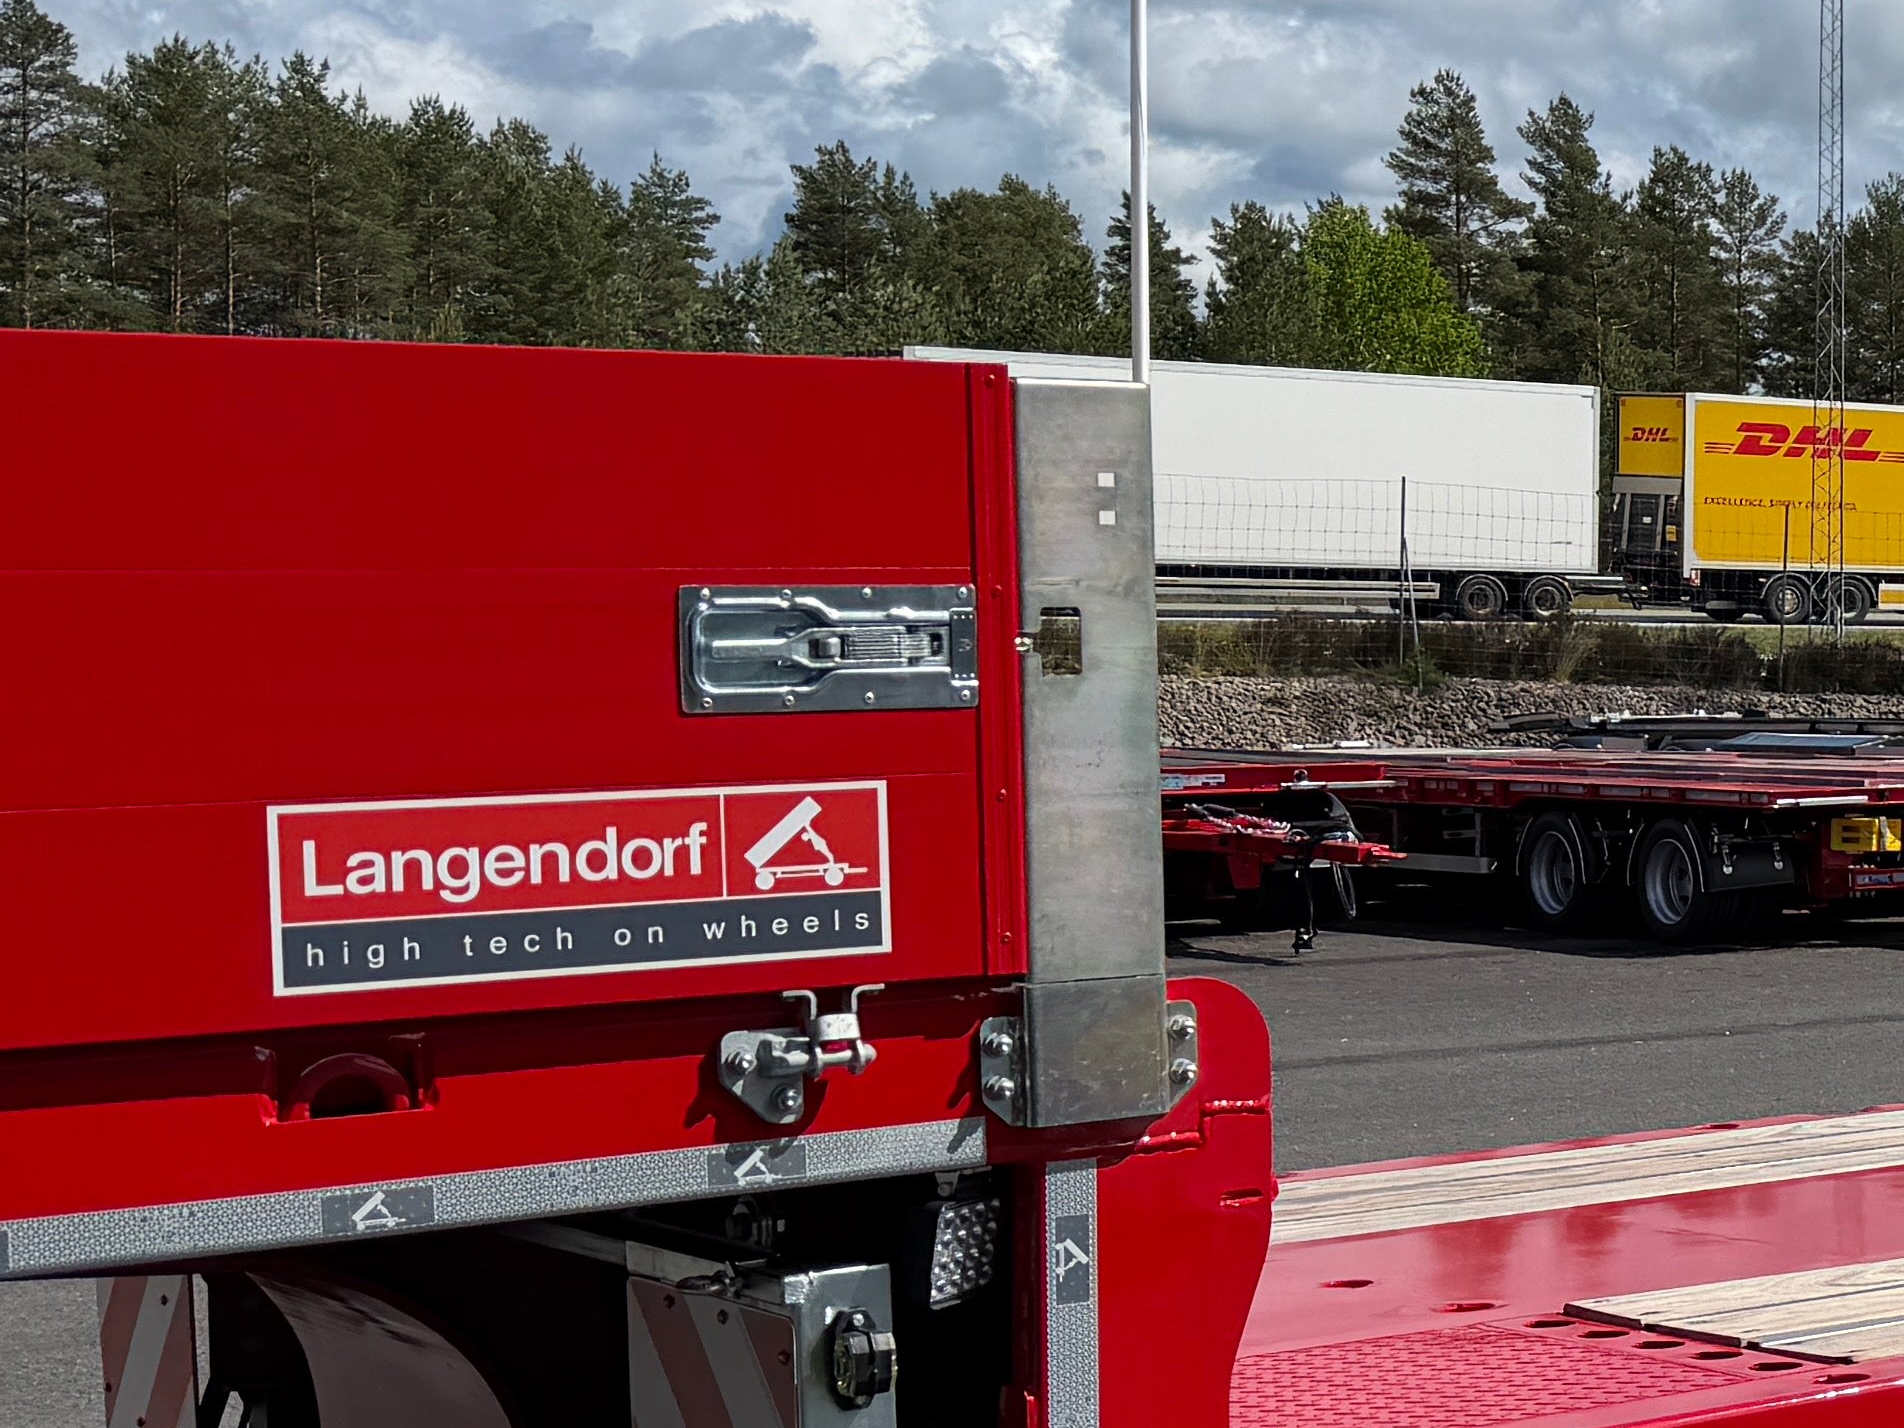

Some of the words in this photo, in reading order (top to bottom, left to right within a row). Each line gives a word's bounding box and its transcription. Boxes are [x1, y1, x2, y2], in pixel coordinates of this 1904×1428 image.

[1631, 426, 1671, 442] DHL
[1731, 421, 1882, 463] DHL
[302, 821, 708, 904] Langendorf
[306, 936, 422, 968] high
[463, 926, 574, 958] tech
[613, 922, 664, 947] on
[703, 902, 871, 941] wheels
